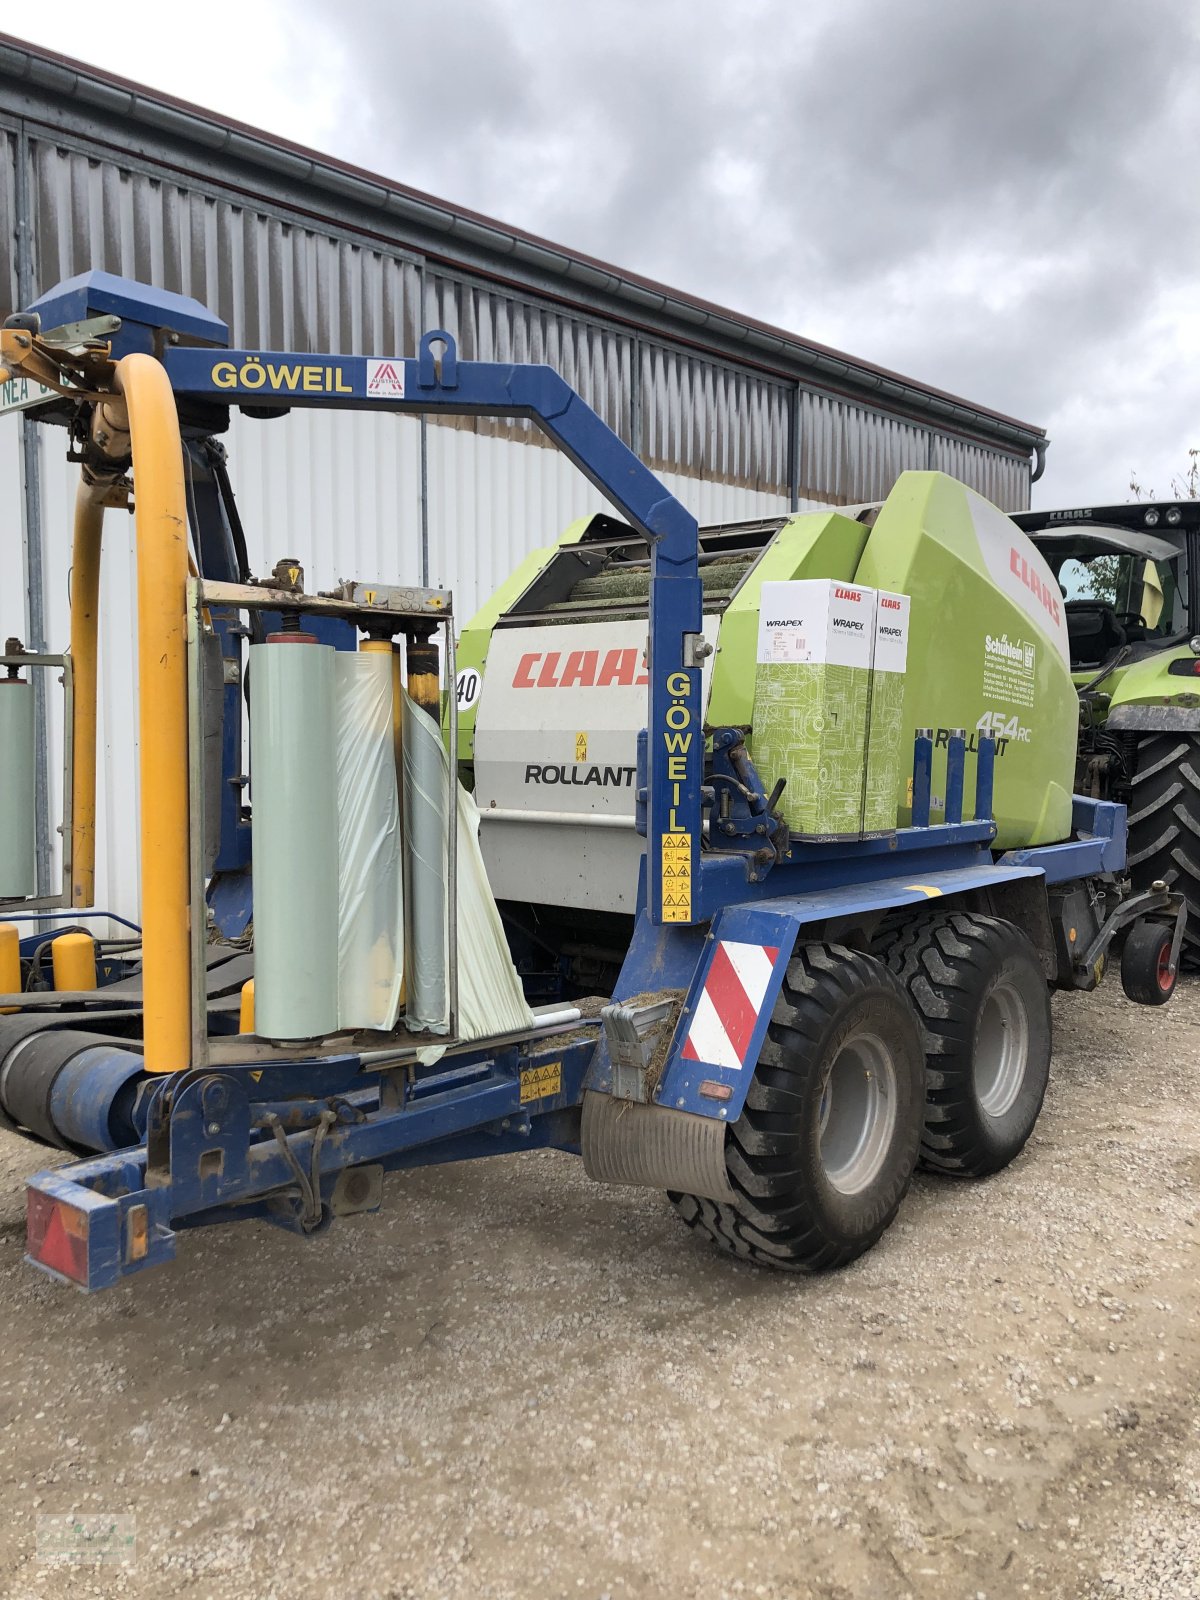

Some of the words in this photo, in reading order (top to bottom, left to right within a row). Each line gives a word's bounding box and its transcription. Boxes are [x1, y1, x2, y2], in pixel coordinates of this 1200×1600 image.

[211, 357, 353, 393] GÖWEIL
[1049, 509, 1093, 521] CLAAS
[835, 588, 862, 602] CLAAS
[1010, 547, 1060, 627] CLAAS
[881, 598, 901, 610] CLAAS
[766, 619, 804, 627] WRAPEX
[833, 617, 865, 631] WRAPEX
[879, 626, 903, 637] WRAPEX
[456, 674, 477, 702] 40
[976, 711, 1018, 740] 454
[1017, 727, 1032, 742] RC
[663, 672, 692, 832] GÖWEIL
[525, 765, 637, 787] ROLLANT
